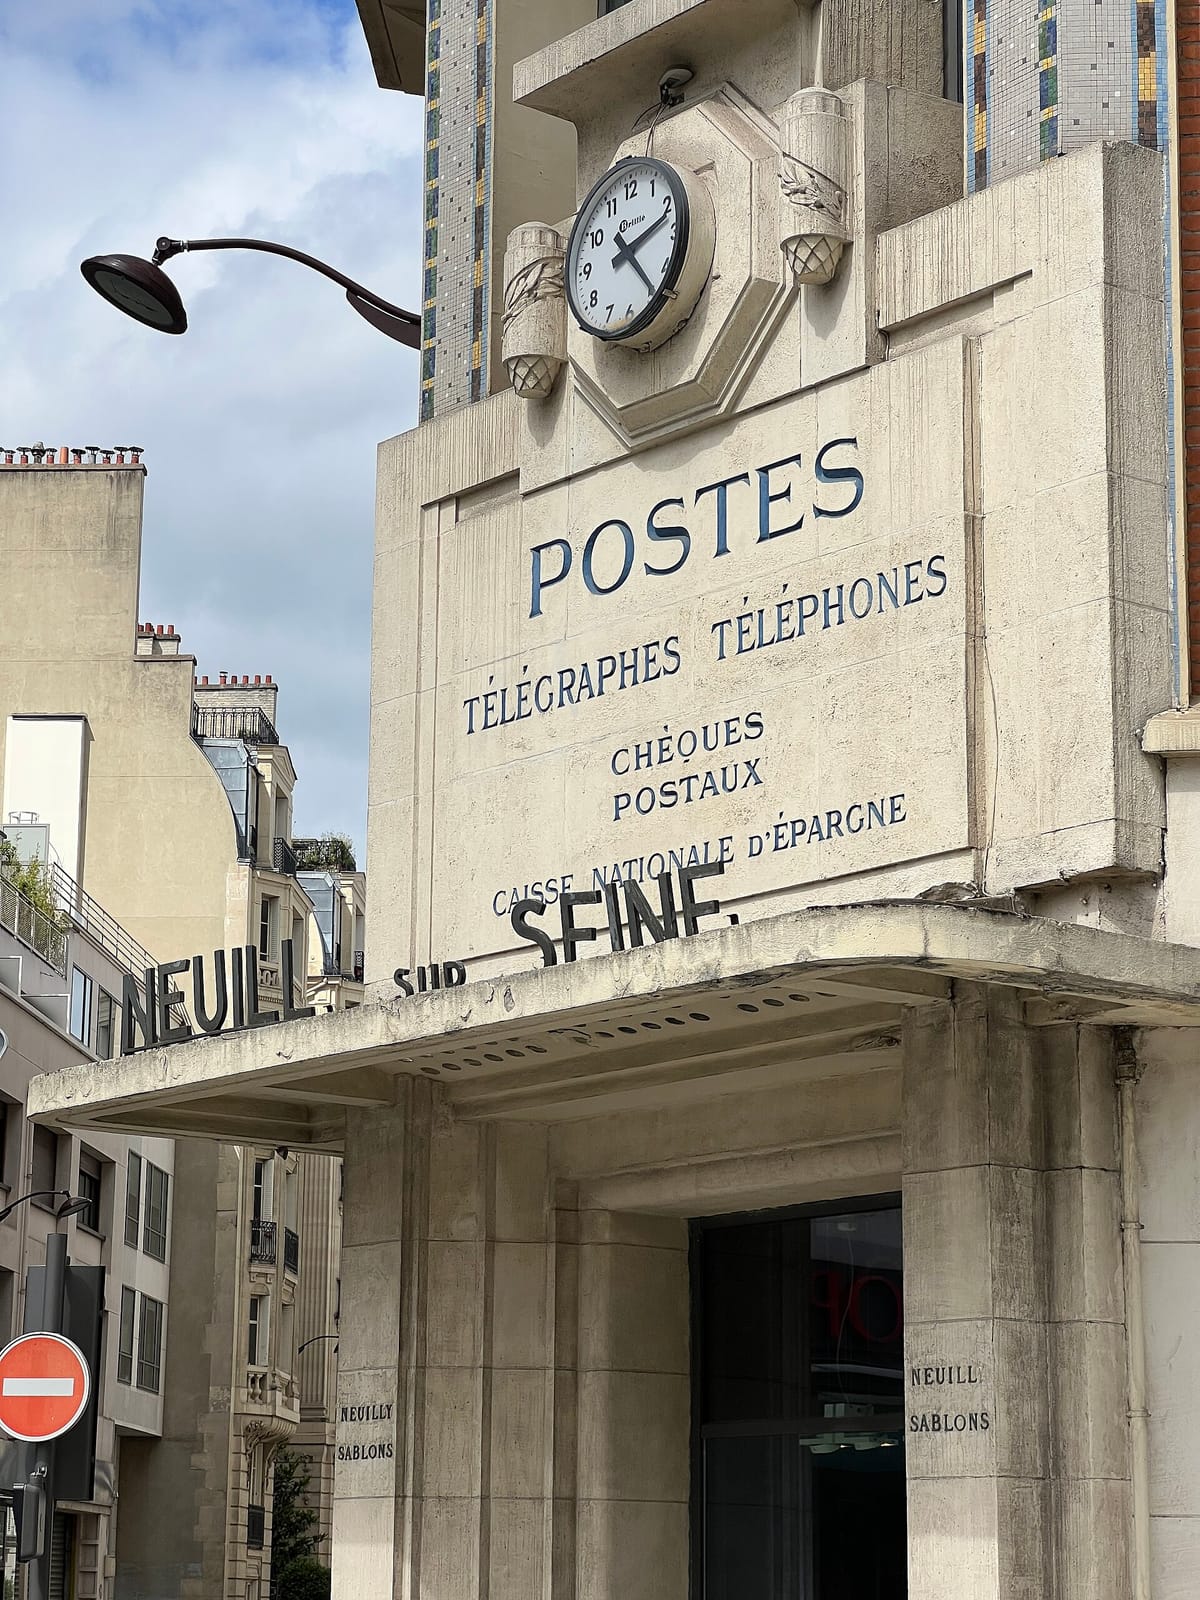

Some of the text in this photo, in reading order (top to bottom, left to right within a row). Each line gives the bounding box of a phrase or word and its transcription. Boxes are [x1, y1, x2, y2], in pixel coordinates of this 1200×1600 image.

[623, 179, 638, 201] 12
[649, 179, 655, 197] 1
[606, 198, 617, 218] 11
[662, 195, 672, 215] 2
[589, 228, 604, 249] 10
[583, 262, 592, 281] 9
[589, 290, 598, 308] 8
[605, 303, 615, 324] 7
[625, 303, 634, 320] 6
[528, 436, 864, 619] POSTES
[462, 555, 947, 735] TÉLÉGRAPHES TÉLÉPHONES
[611, 712, 764, 776] CHÈQUES
[613, 758, 764, 822] POSTAUX
[492, 794, 908, 917] CAISSE NATIONALE D'ÉPARGNE
[340, 1404, 393, 1422] NEUILLY
[910, 1412, 990, 1433] SABLONS
[338, 1443, 393, 1461] SABLONS
